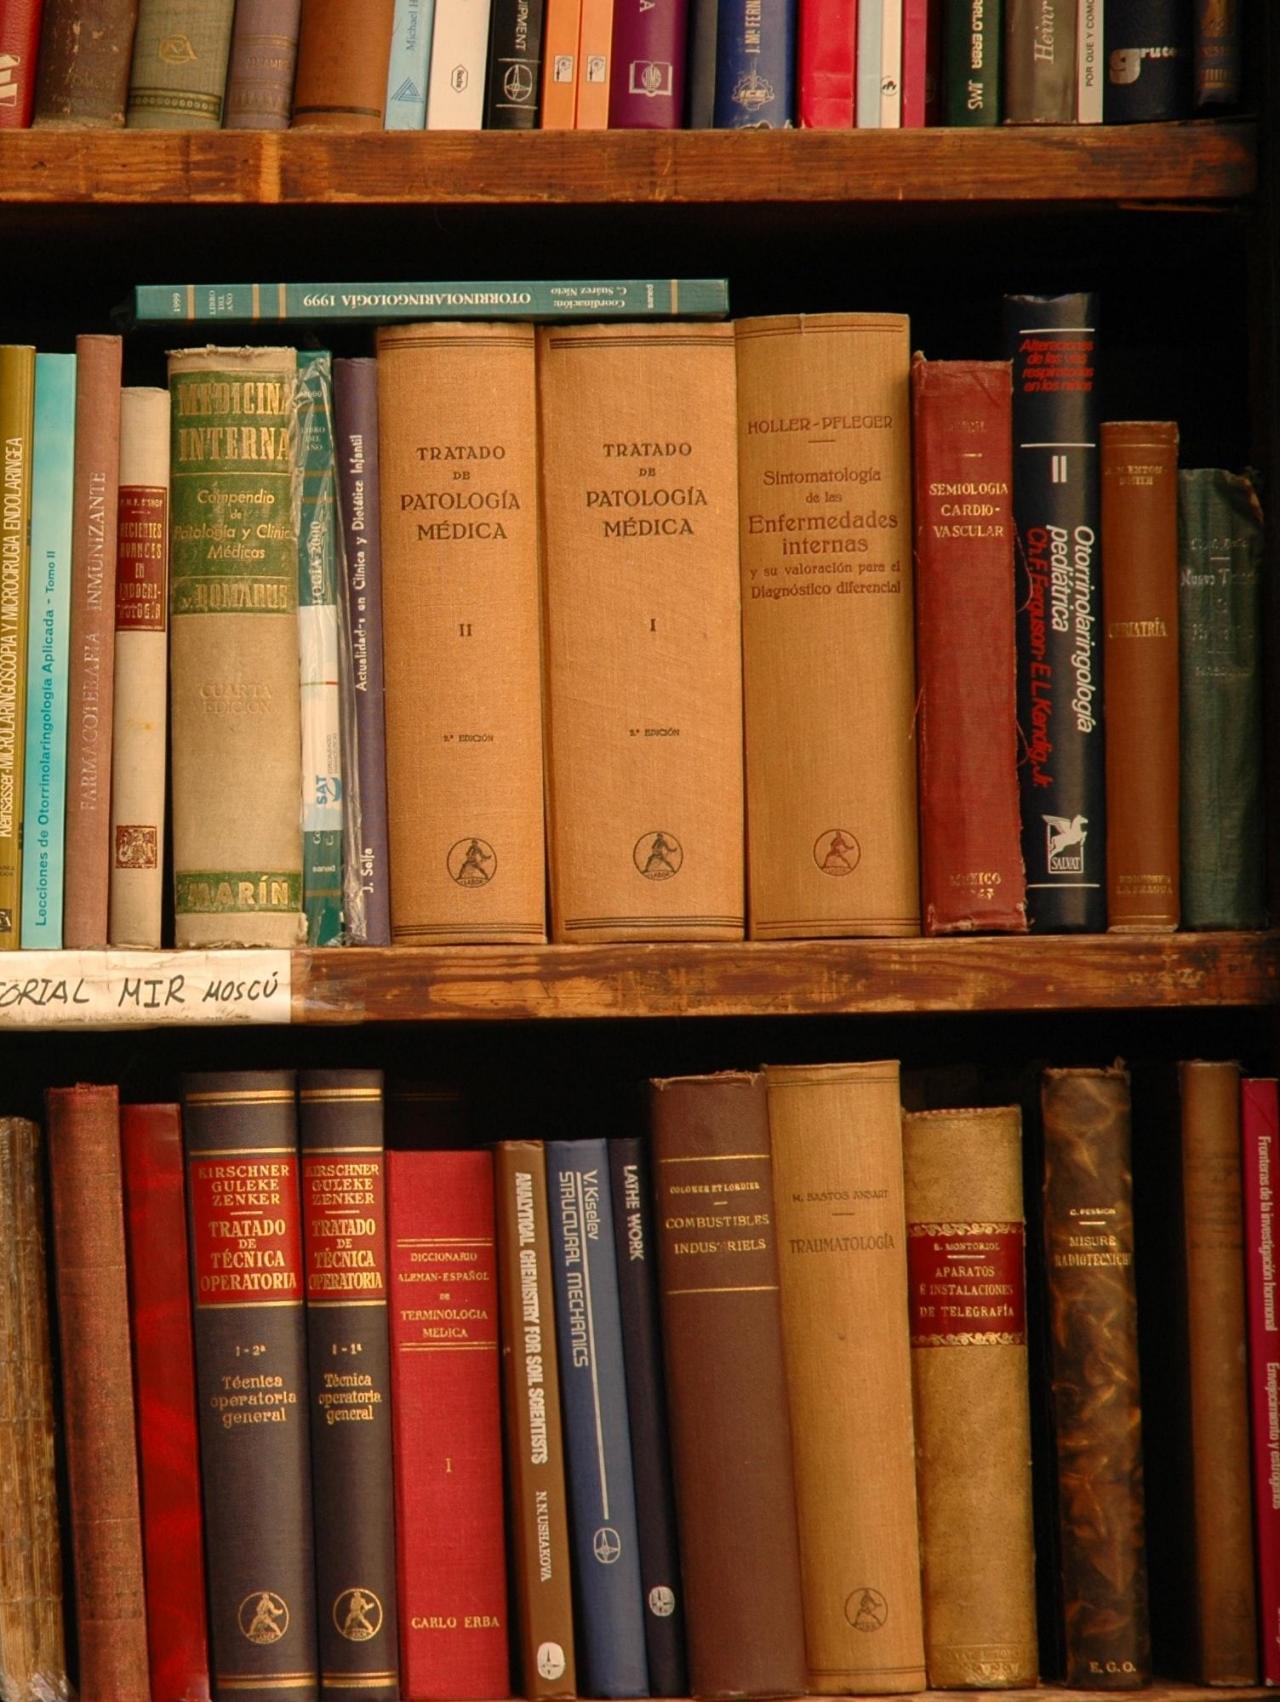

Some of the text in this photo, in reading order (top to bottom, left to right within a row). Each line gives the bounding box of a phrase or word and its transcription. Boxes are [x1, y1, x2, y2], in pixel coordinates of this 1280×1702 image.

[1086, 42, 1094, 87] POR QUE
[302, 292, 532, 309] OTORRINOLARINGOLOGÍA 1999
[177, 426, 291, 462] INTERNA
[416, 444, 507, 463] TRATADO
[602, 443, 693, 462] TRATADO
[452, 470, 471, 482] DE
[638, 468, 656, 479] DE
[763, 466, 882, 487] Sintomatología
[197, 487, 275, 507] Compendio
[400, 489, 520, 513] PATOLOGÍA
[585, 485, 708, 511] PATOLOGÍA
[928, 482, 1009, 498] SEMIOLOGIA
[940, 502, 1000, 518] CARDIO-
[1, 437, 24, 621] MICROCIRUGIA ENDOLARINGEA
[416, 518, 508, 542] MÉDICA
[602, 515, 695, 539] MÉDICA
[748, 509, 898, 535] Enfermedades
[933, 524, 1005, 540] VASCULAR
[86, 471, 107, 612] INMUNIZANTE
[206, 543, 266, 560] Médicas
[782, 534, 869, 557] internas
[784, 560, 853, 577] valoración
[1045, 523, 1073, 633] pediátrica
[751, 582, 832, 601] Diagnóstico
[1070, 525, 1096, 734] Otorrinolaringología
[35, 607, 56, 927] Lecciones Otorrinolaringología Aplicada
[119, 977, 186, 1010] MIR
[203, 970, 279, 1002] MOSCÚ
[197, 1163, 291, 1181] KIRSCHNER
[210, 1178, 281, 1195] GULEKE
[311, 1178, 375, 1194] GULEKE
[212, 1192, 282, 1208] ZENKER
[311, 1192, 376, 1207] ZENKER
[623, 1164, 644, 1261] LATHE WORK
[665, 1212, 771, 1231] COMBUSTIBLES
[207, 1217, 288, 1239] TRATADO
[311, 1217, 378, 1238] TRATADO
[1257, 1135, 1279, 1332] Fronteras investigación hormonal
[238, 1238, 258, 1250] DE
[336, 1238, 353, 1250] DE
[788, 1231, 896, 1256] TRAUMATOLOGÍA
[210, 1248, 287, 1270] TÉCNICA
[314, 1248, 377, 1270] TÉCNICA
[559, 1170, 589, 1368] STRUCTURAL MECHANICS
[199, 1270, 298, 1294] OPERATORIA
[307, 1271, 384, 1293] OPERATORIA
[514, 1171, 548, 1465] ANALYTICAL CHEMISTRY FOR SOIL SCIENTISTS
[939, 1302, 1015, 1319] TELEGRAFÍA
[422, 1326, 470, 1340] MEDICA
[221, 1408, 289, 1430] general
[325, 1405, 375, 1427] general
[410, 1614, 501, 1631] CARLO ERBA
